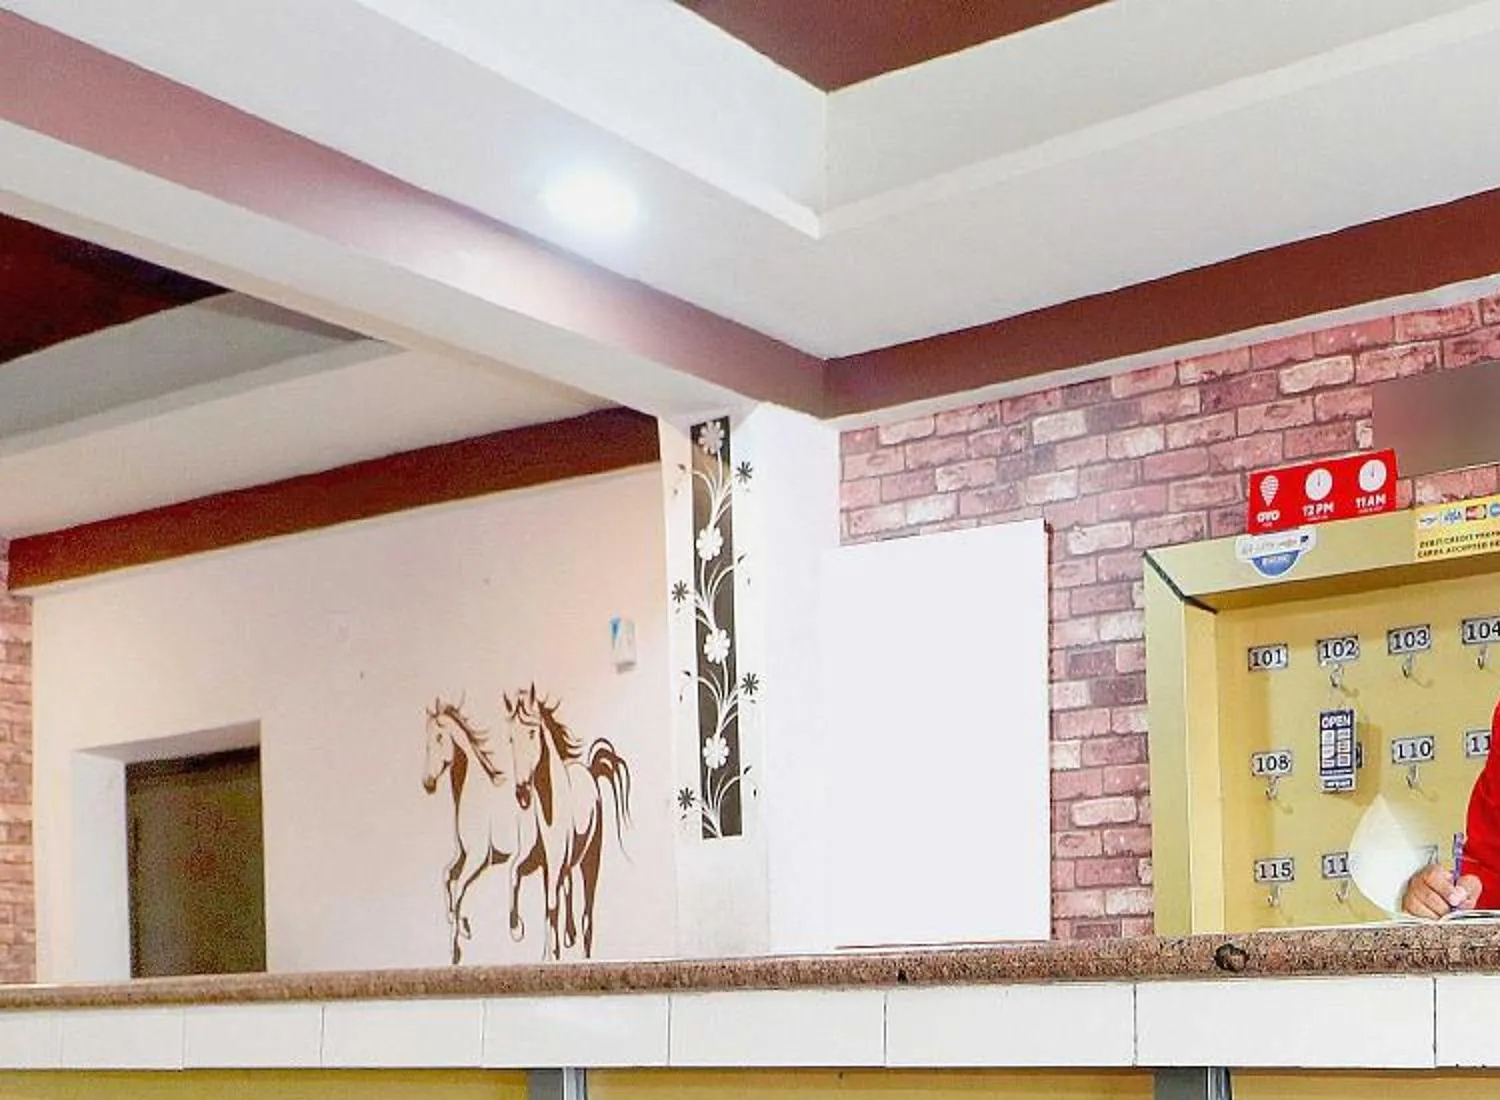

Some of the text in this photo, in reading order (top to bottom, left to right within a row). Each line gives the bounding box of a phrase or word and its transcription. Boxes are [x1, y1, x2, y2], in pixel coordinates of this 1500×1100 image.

[1302, 501, 1334, 517] 12 PM
[1355, 493, 1387, 509] 11 AM
[1257, 510, 1280, 523] OYO
[1393, 629, 1428, 650] 103
[1252, 649, 1283, 667] 101
[1323, 640, 1357, 659] 102
[1322, 715, 1351, 729] OPEN
[1398, 741, 1432, 759] 110
[1471, 735, 1491, 752] 11
[1256, 756, 1289, 773] 108
[1258, 861, 1293, 879] 115
[1327, 856, 1348, 873] 11
